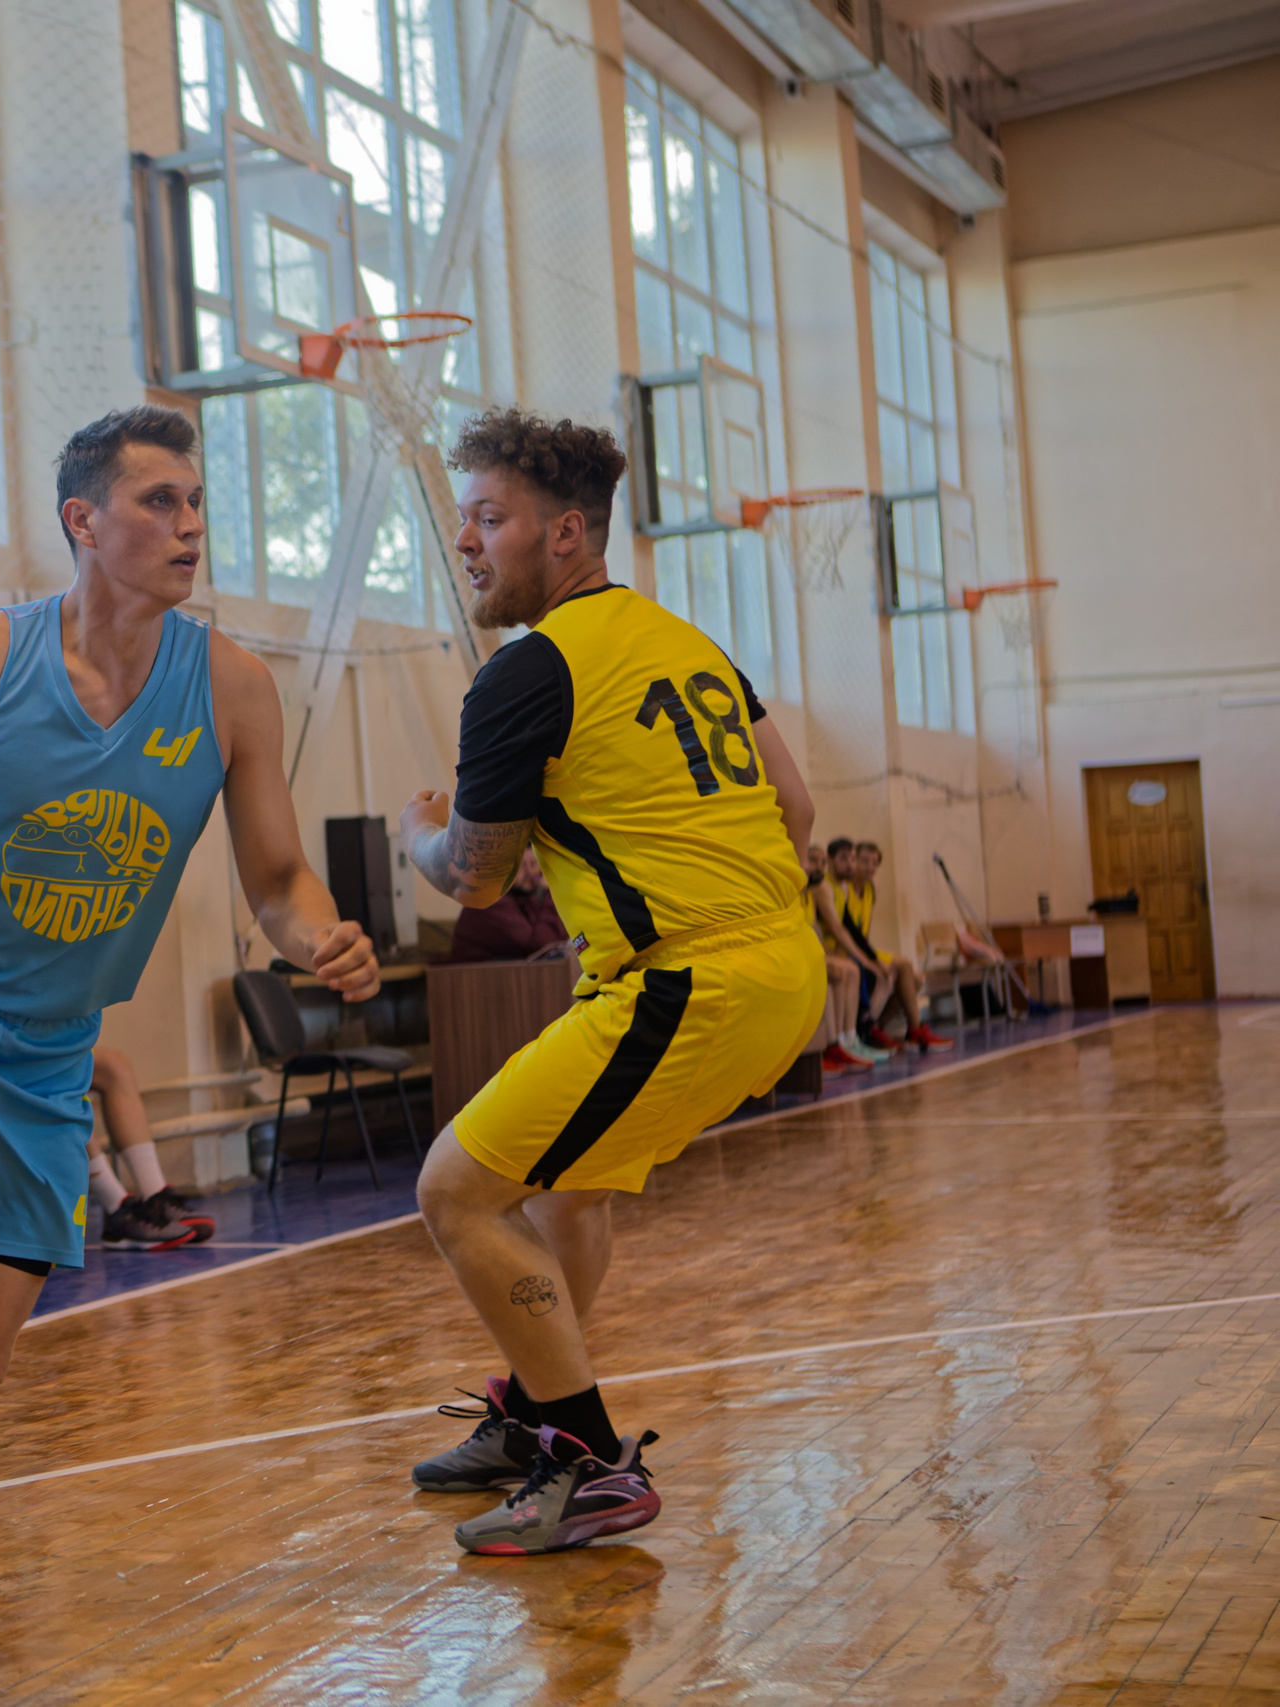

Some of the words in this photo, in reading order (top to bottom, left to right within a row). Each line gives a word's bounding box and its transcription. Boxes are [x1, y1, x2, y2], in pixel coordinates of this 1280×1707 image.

[142, 727, 203, 767] 41
[635, 671, 759, 797] 18
[0, 872, 154, 943] ПИТОНЫ
